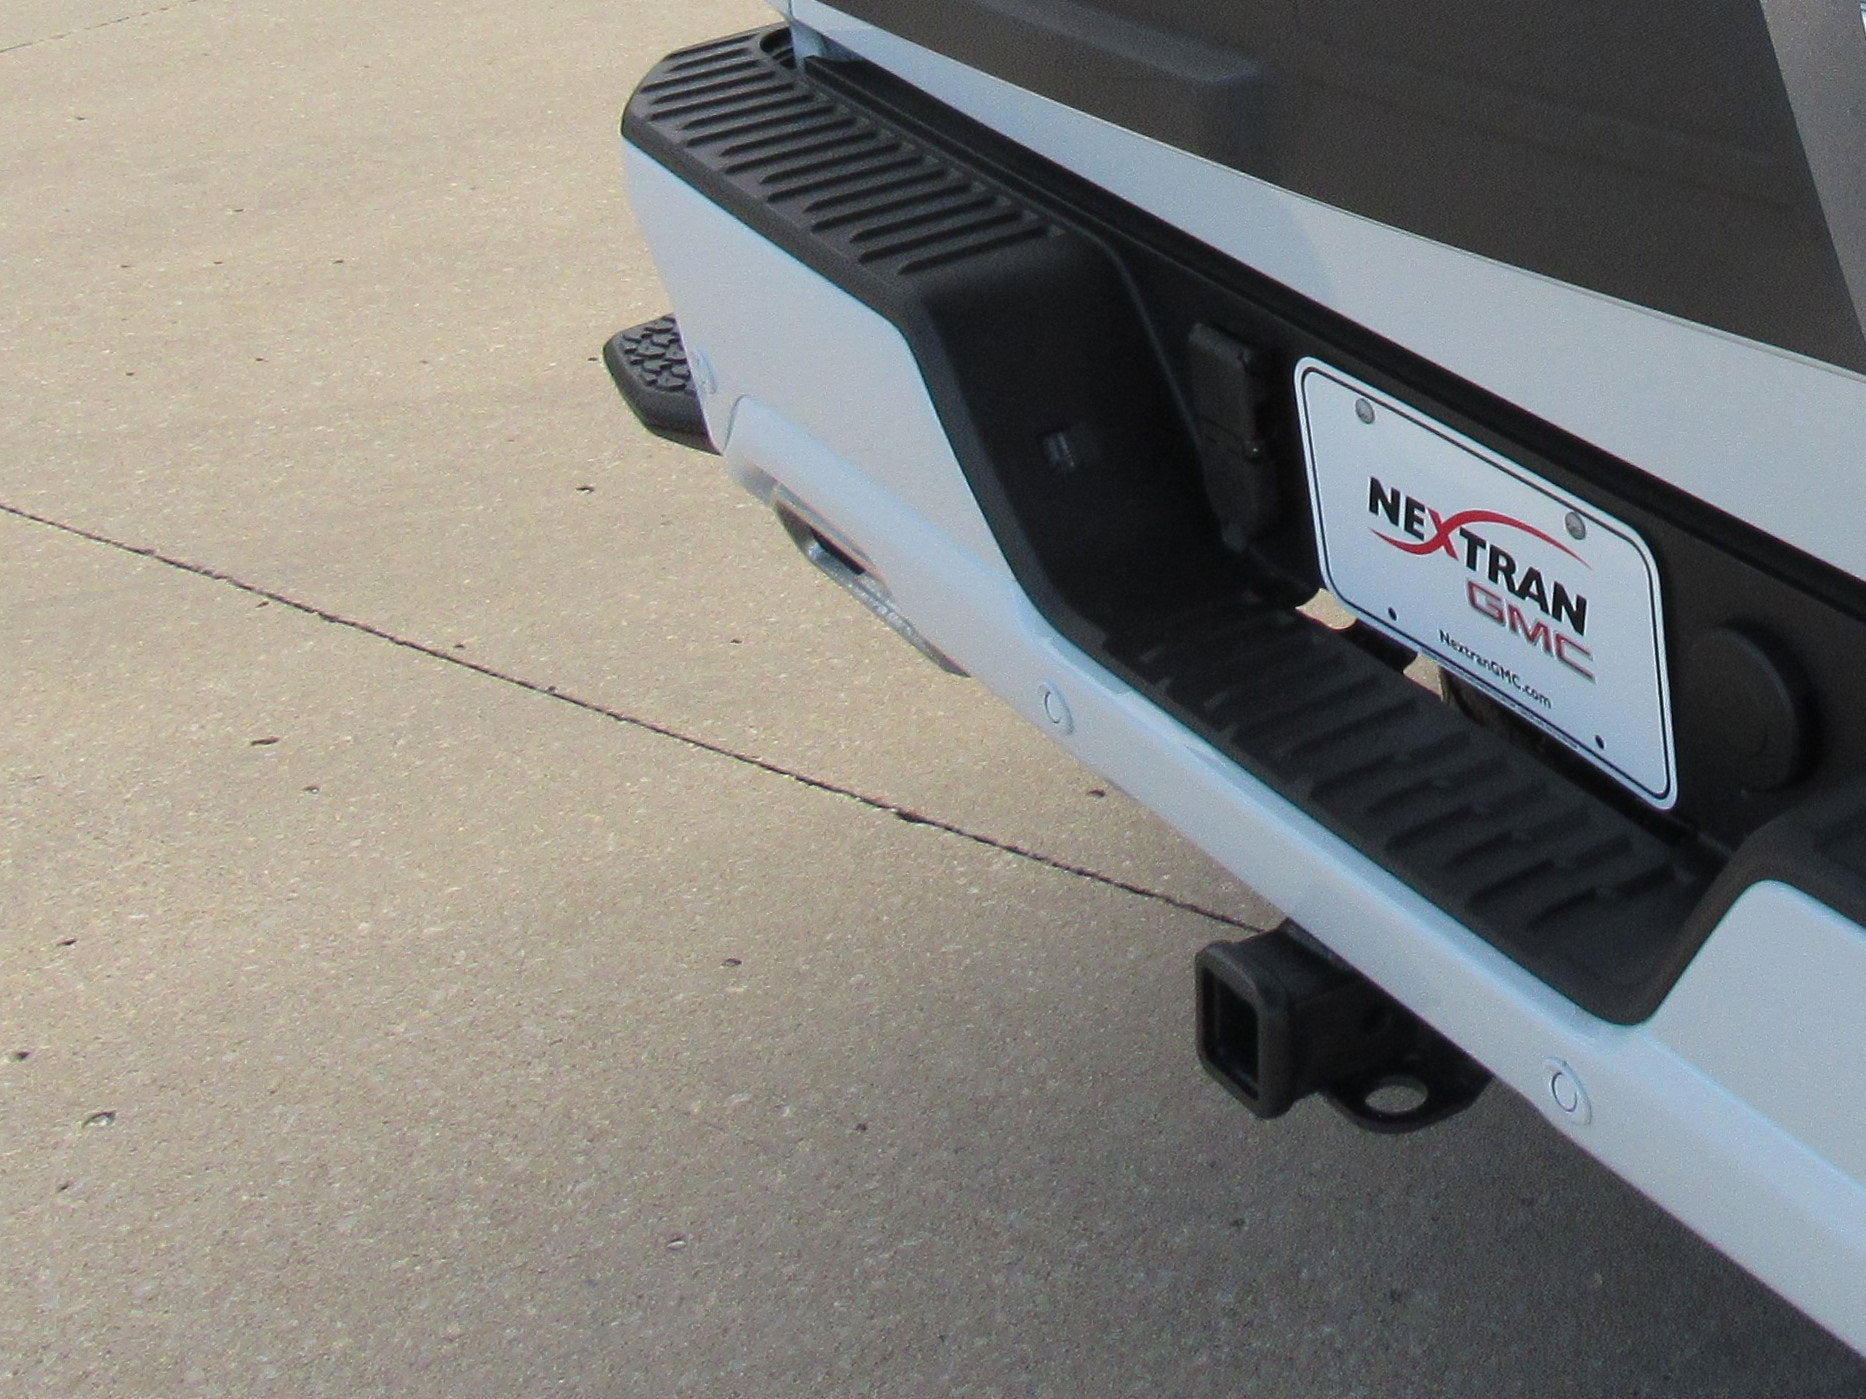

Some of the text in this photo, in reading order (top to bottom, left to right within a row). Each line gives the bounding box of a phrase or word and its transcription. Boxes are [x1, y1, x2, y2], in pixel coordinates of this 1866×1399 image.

[1368, 477, 1588, 636] NEXTRAN
[1439, 629, 1552, 709] NextranGMC.com
[1467, 580, 1594, 680] GMC
